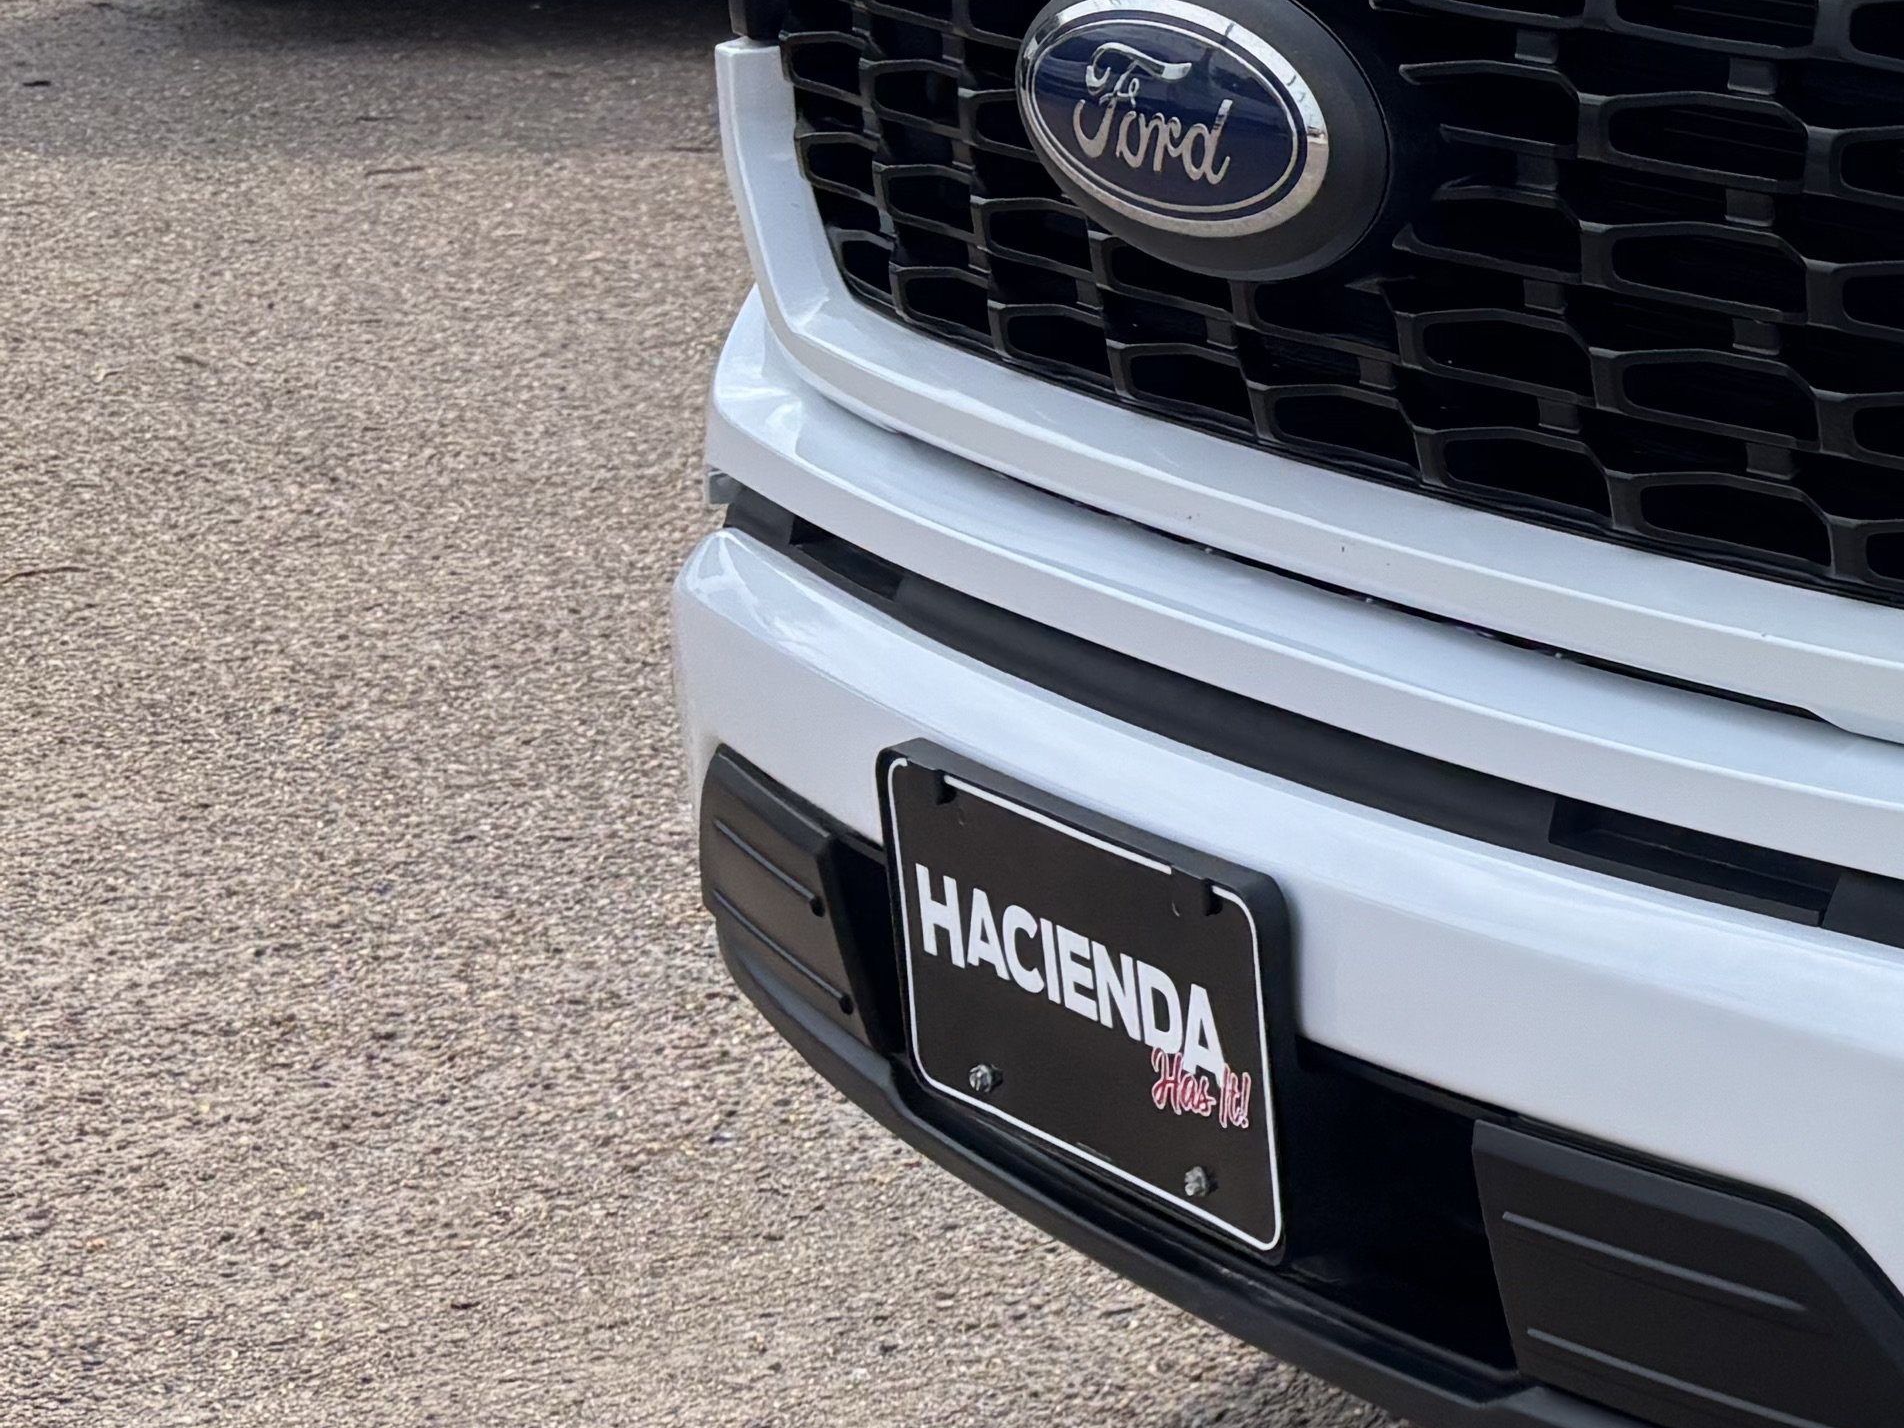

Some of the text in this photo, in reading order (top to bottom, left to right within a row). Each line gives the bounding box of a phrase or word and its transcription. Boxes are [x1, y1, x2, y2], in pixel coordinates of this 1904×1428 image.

[1072, 41, 1233, 185] Ford
[915, 862, 1227, 1088] HACIENDA
[1151, 1046, 1251, 1129] Has It!
